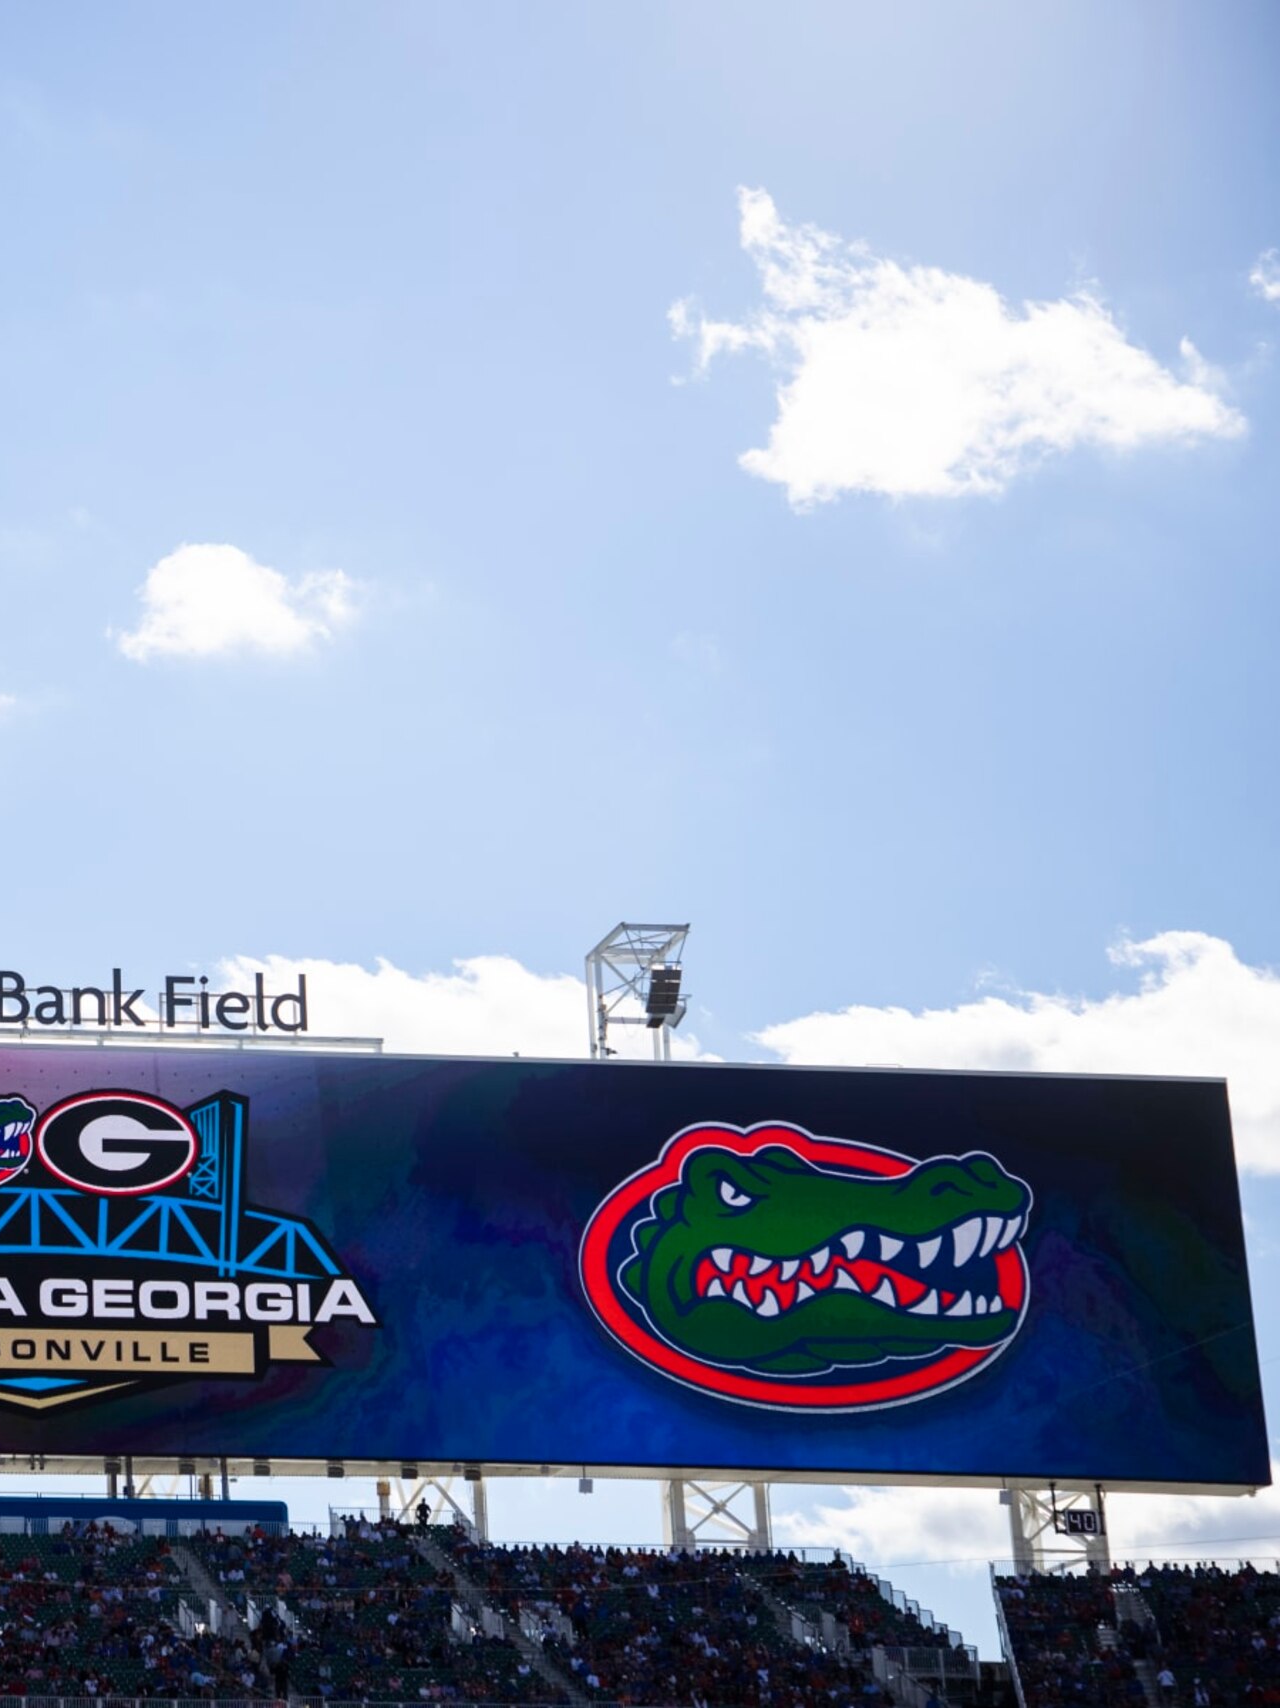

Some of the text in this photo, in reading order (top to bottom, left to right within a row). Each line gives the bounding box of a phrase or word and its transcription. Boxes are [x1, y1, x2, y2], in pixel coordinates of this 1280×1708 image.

[166, 972, 308, 1031] Field
[39, 1278, 376, 1323] GEORGIA
[1070, 1513, 1095, 1531] 40
